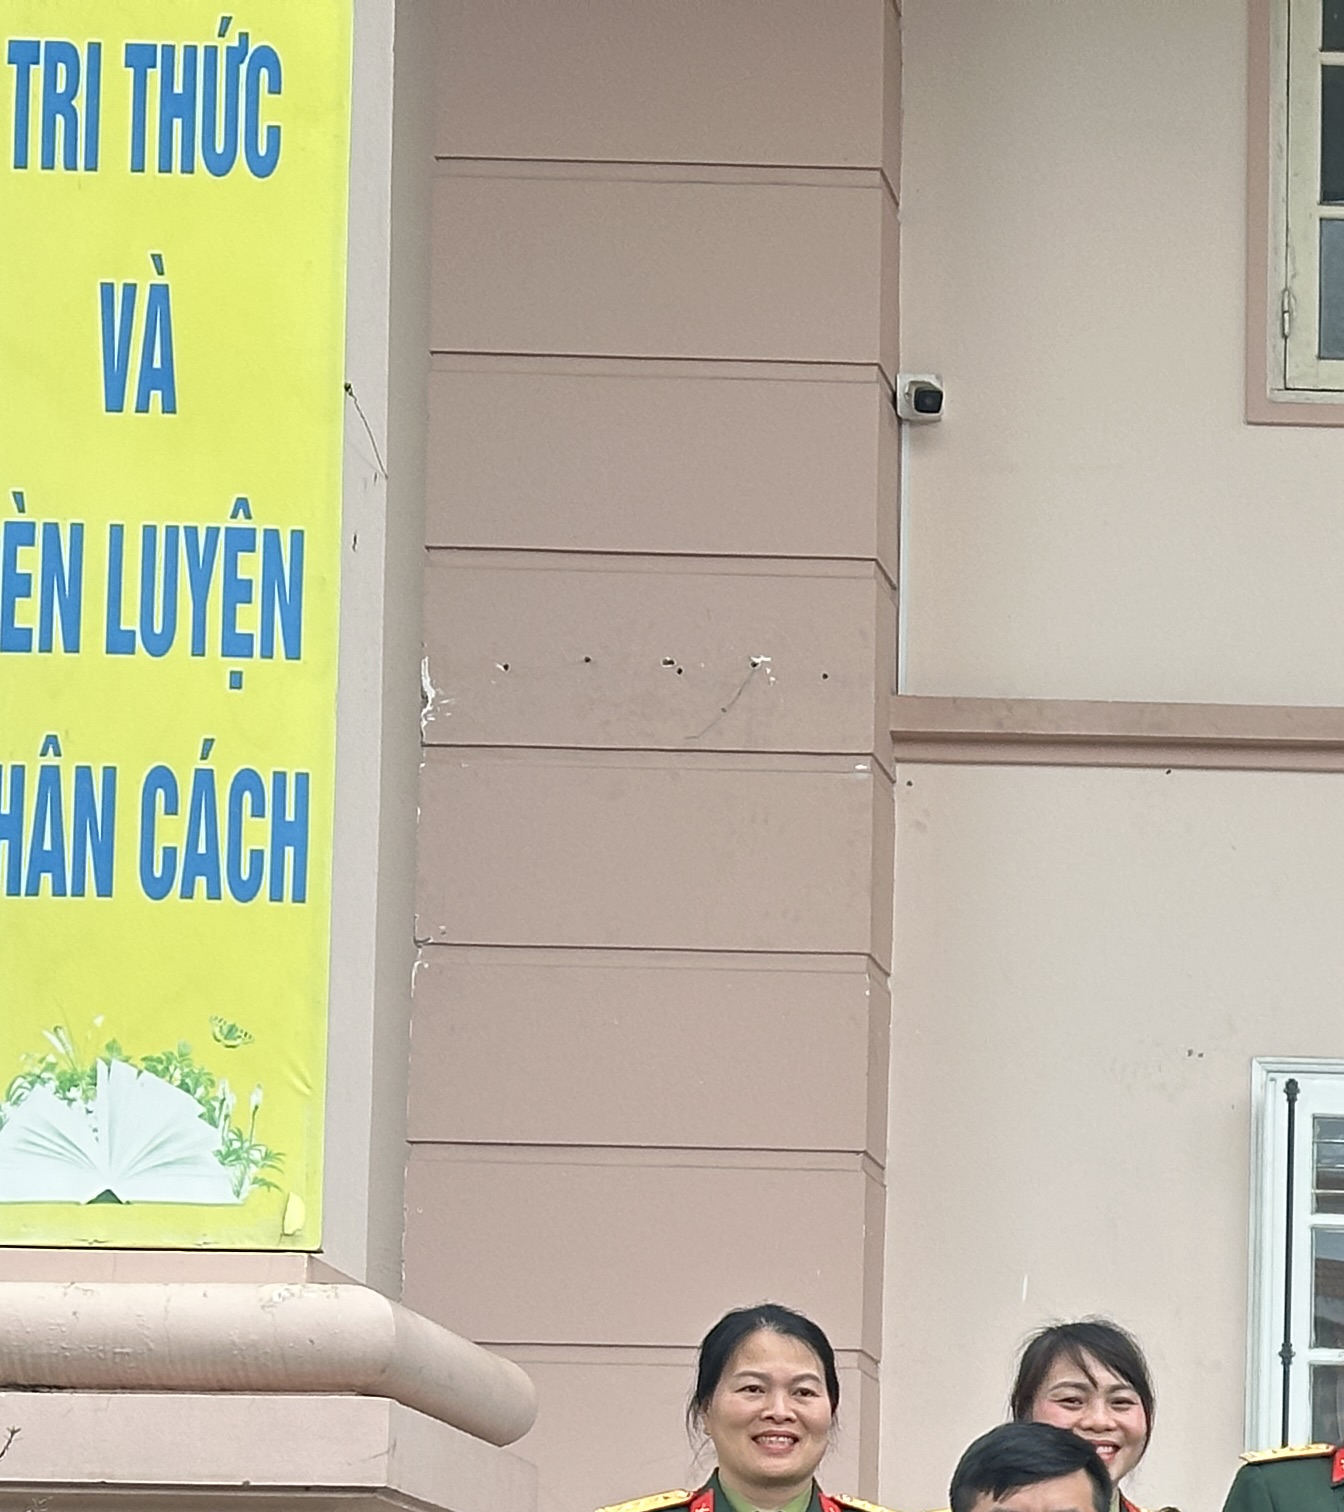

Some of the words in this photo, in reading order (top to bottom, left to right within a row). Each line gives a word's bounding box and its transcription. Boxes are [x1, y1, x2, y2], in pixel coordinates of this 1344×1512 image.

[7, 39, 101, 171] TRI
[124, 16, 282, 178] THỨC
[100, 253, 177, 413] VÀ
[105, 497, 305, 690] LUYỆN
[139, 738, 309, 903] CÁCH
